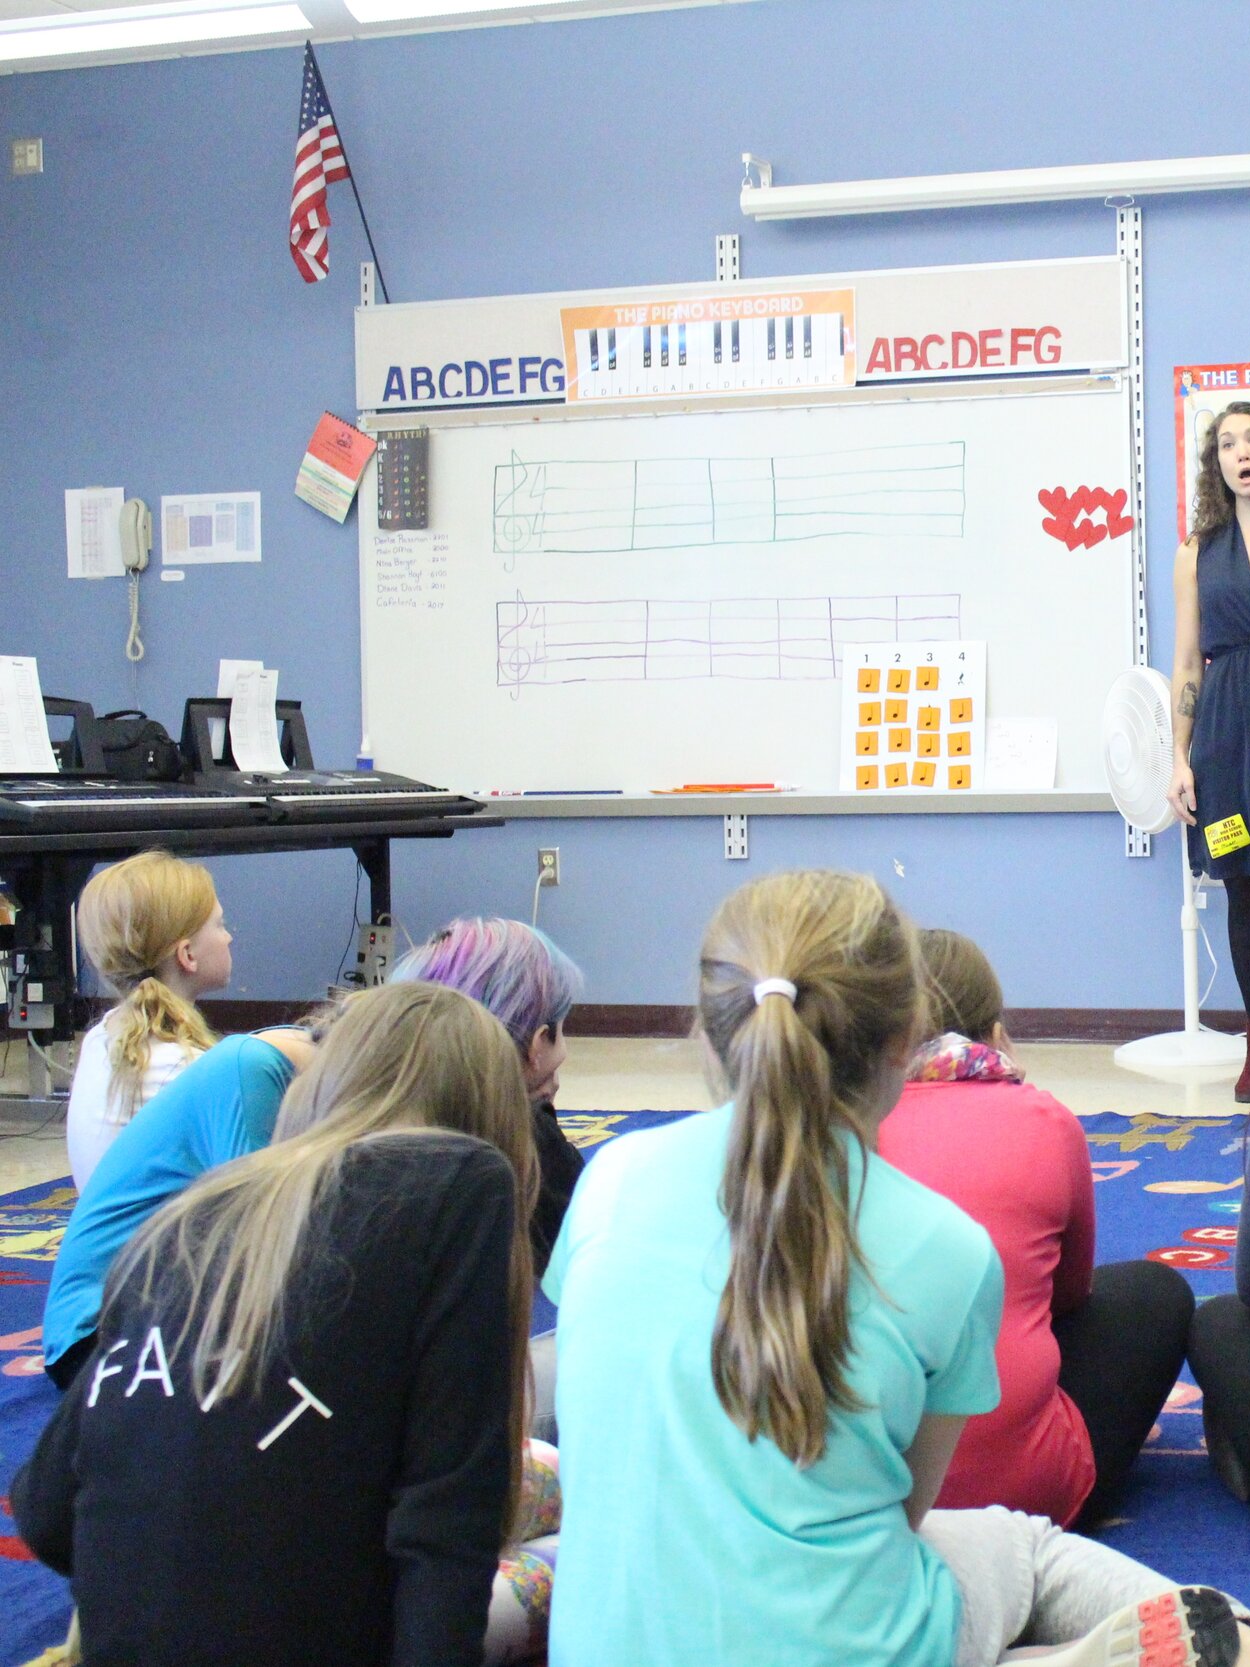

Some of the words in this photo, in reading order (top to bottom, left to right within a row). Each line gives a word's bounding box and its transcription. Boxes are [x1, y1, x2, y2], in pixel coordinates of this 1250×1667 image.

[614, 306, 647, 322] THE
[652, 302, 704, 320] PIANO
[709, 297, 804, 317] KEYBOARD
[1200, 370, 1238, 386] THE
[864, 654, 869, 663] 1
[894, 653, 901, 663] 2
[926, 652, 933, 662] 3
[958, 652, 966, 662] 4
